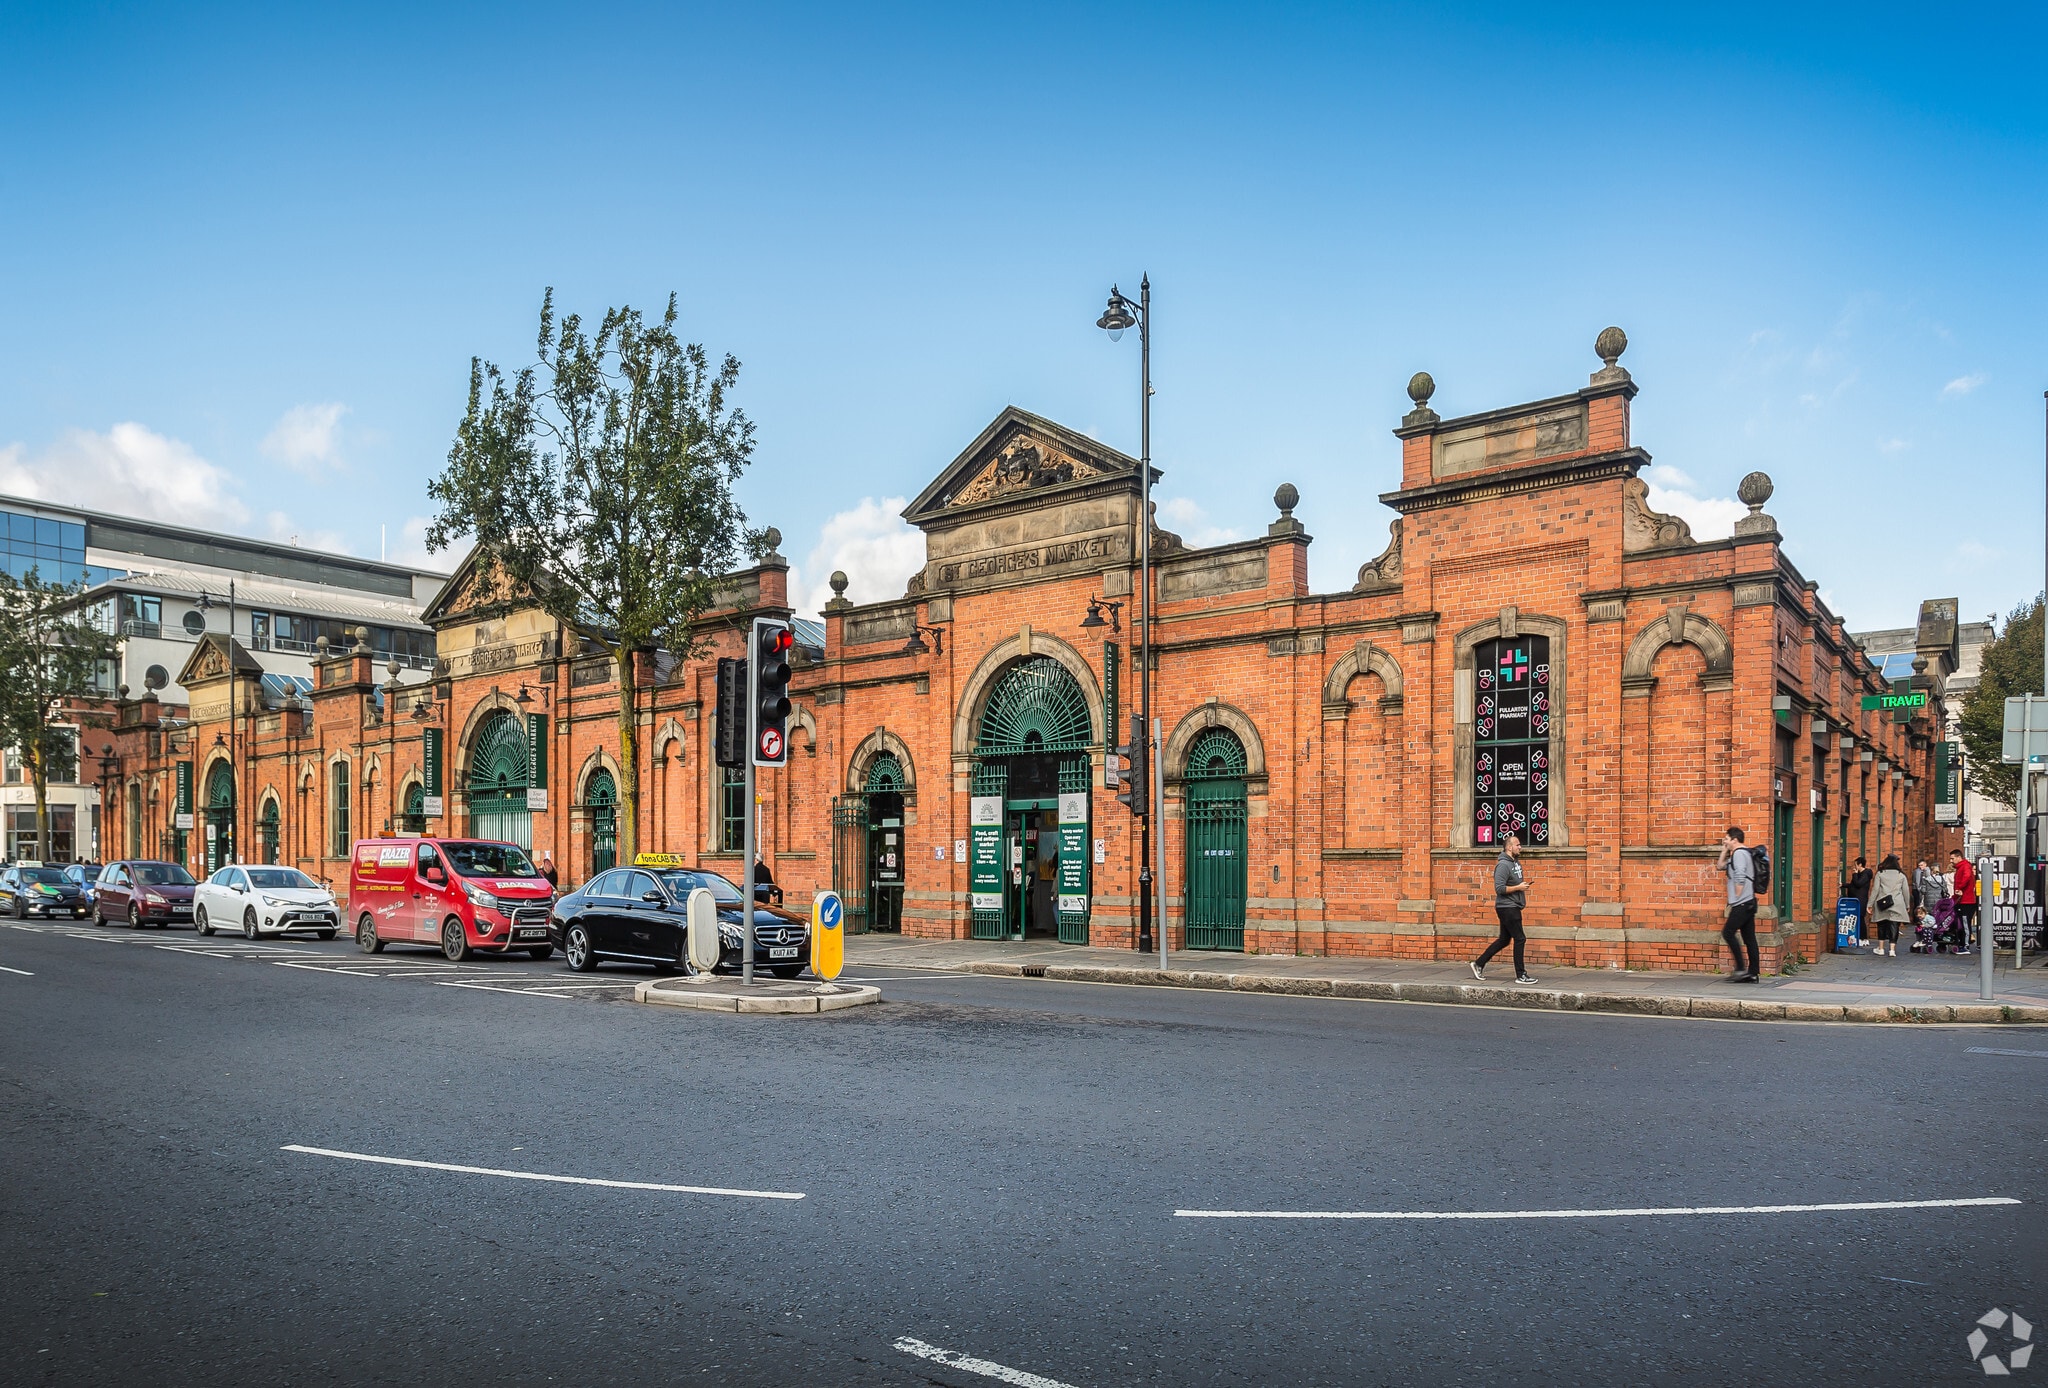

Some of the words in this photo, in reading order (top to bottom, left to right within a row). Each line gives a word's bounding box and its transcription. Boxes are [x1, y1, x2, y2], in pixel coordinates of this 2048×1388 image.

[944, 564, 962, 582] ST
[968, 550, 1039, 578] GEORGE'S
[1045, 537, 1111, 565] MARKET
[1108, 742, 1112, 753] ST
[379, 848, 411, 865] FRAZER
